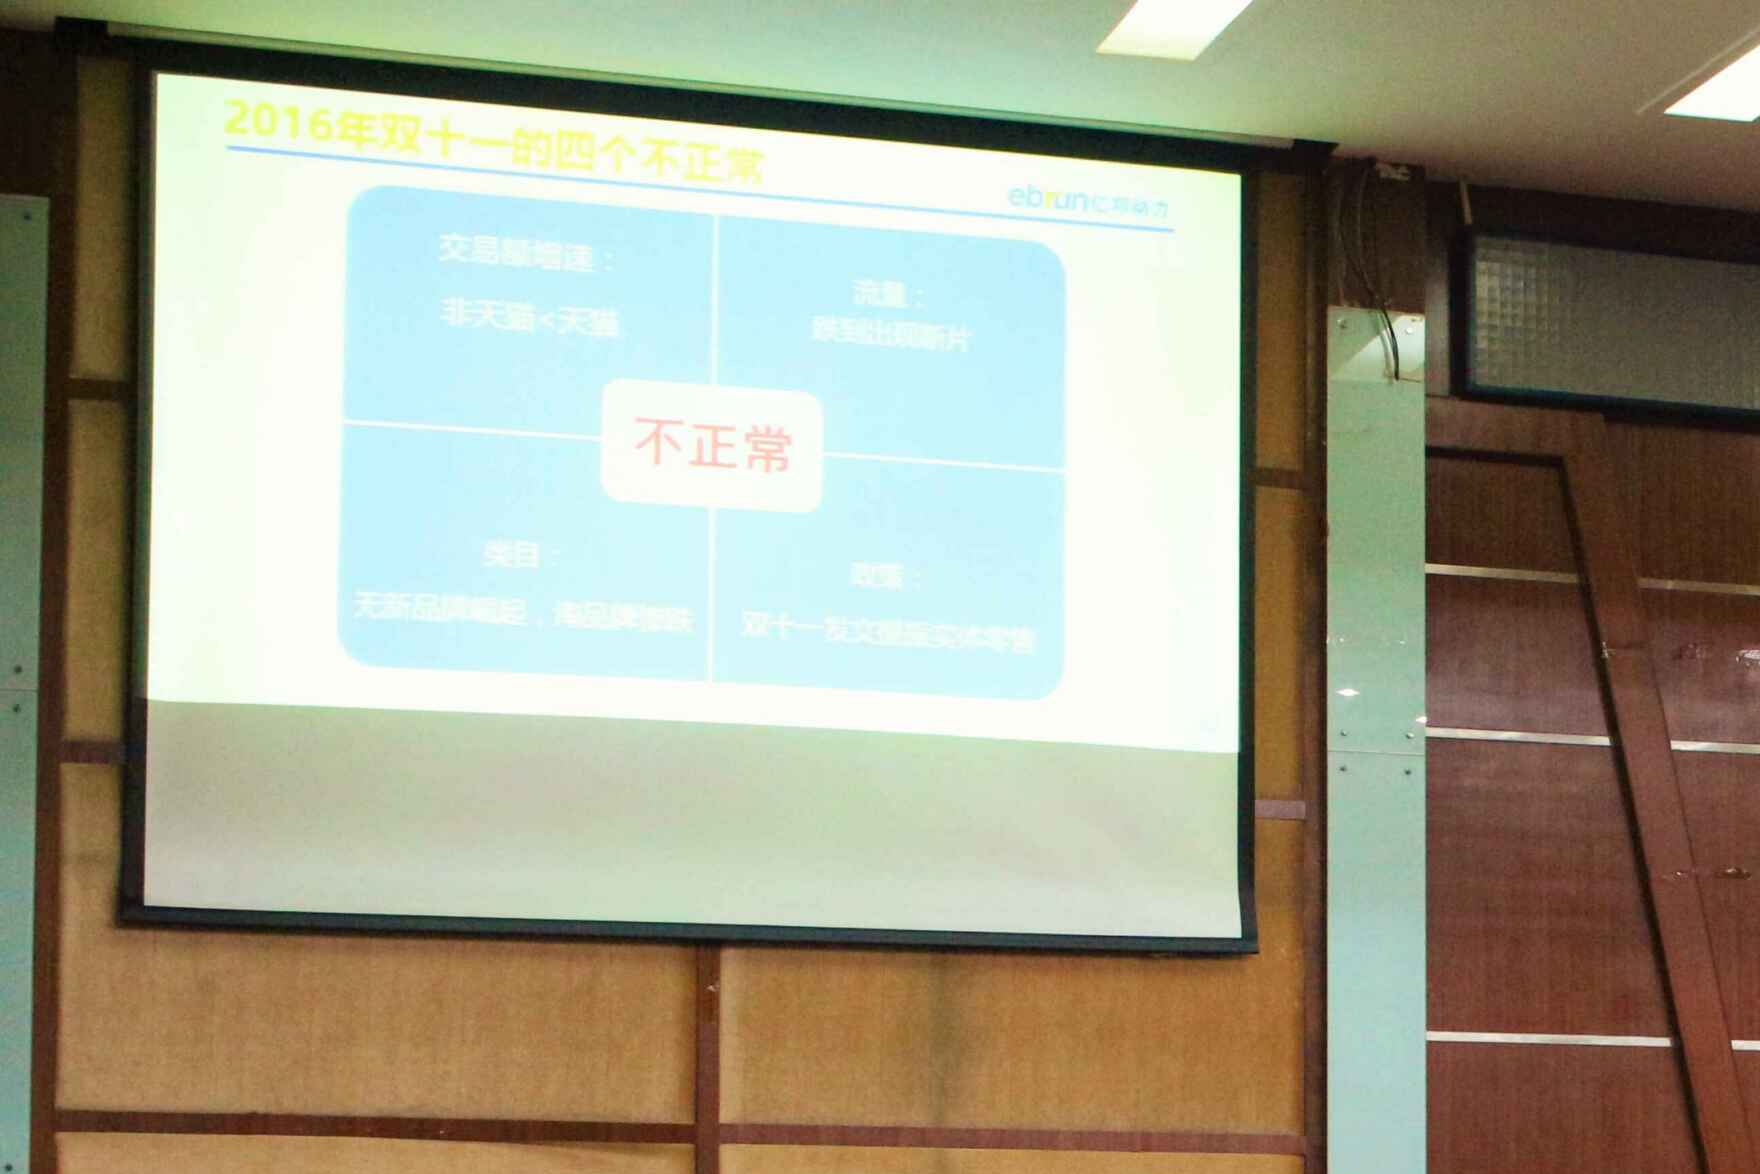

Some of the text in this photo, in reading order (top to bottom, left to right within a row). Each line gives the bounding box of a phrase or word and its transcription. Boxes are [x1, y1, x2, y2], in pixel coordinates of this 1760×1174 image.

[223, 98, 766, 186] 2016年双十一的四个不正常
[633, 416, 793, 474] 不正常
